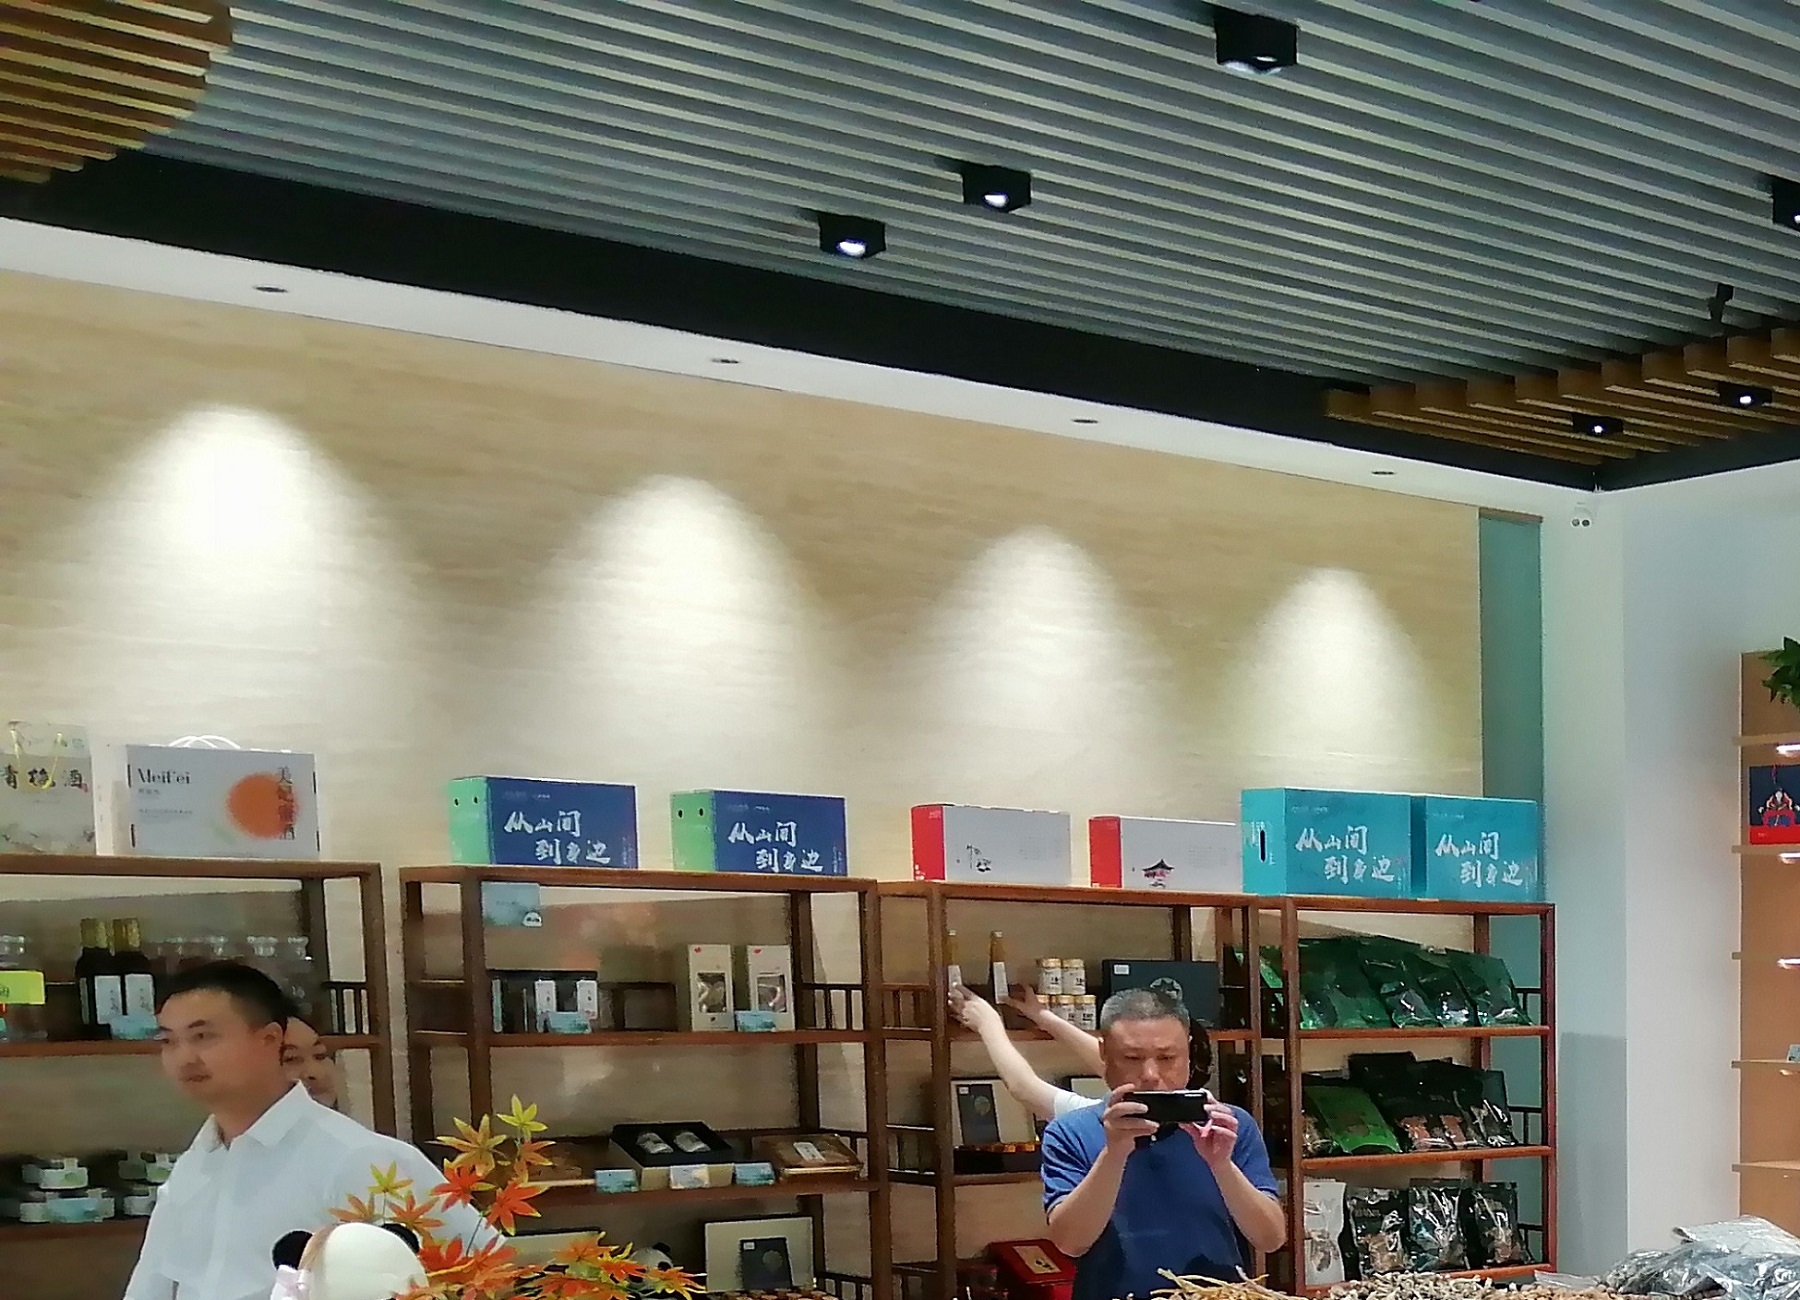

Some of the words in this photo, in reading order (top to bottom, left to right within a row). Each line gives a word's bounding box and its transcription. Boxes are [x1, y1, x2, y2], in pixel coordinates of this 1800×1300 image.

[504, 810, 582, 838] 从山间
[727, 821, 798, 848] 从山间
[1296, 826, 1369, 856] 从山间
[1435, 831, 1501, 860] 从山间
